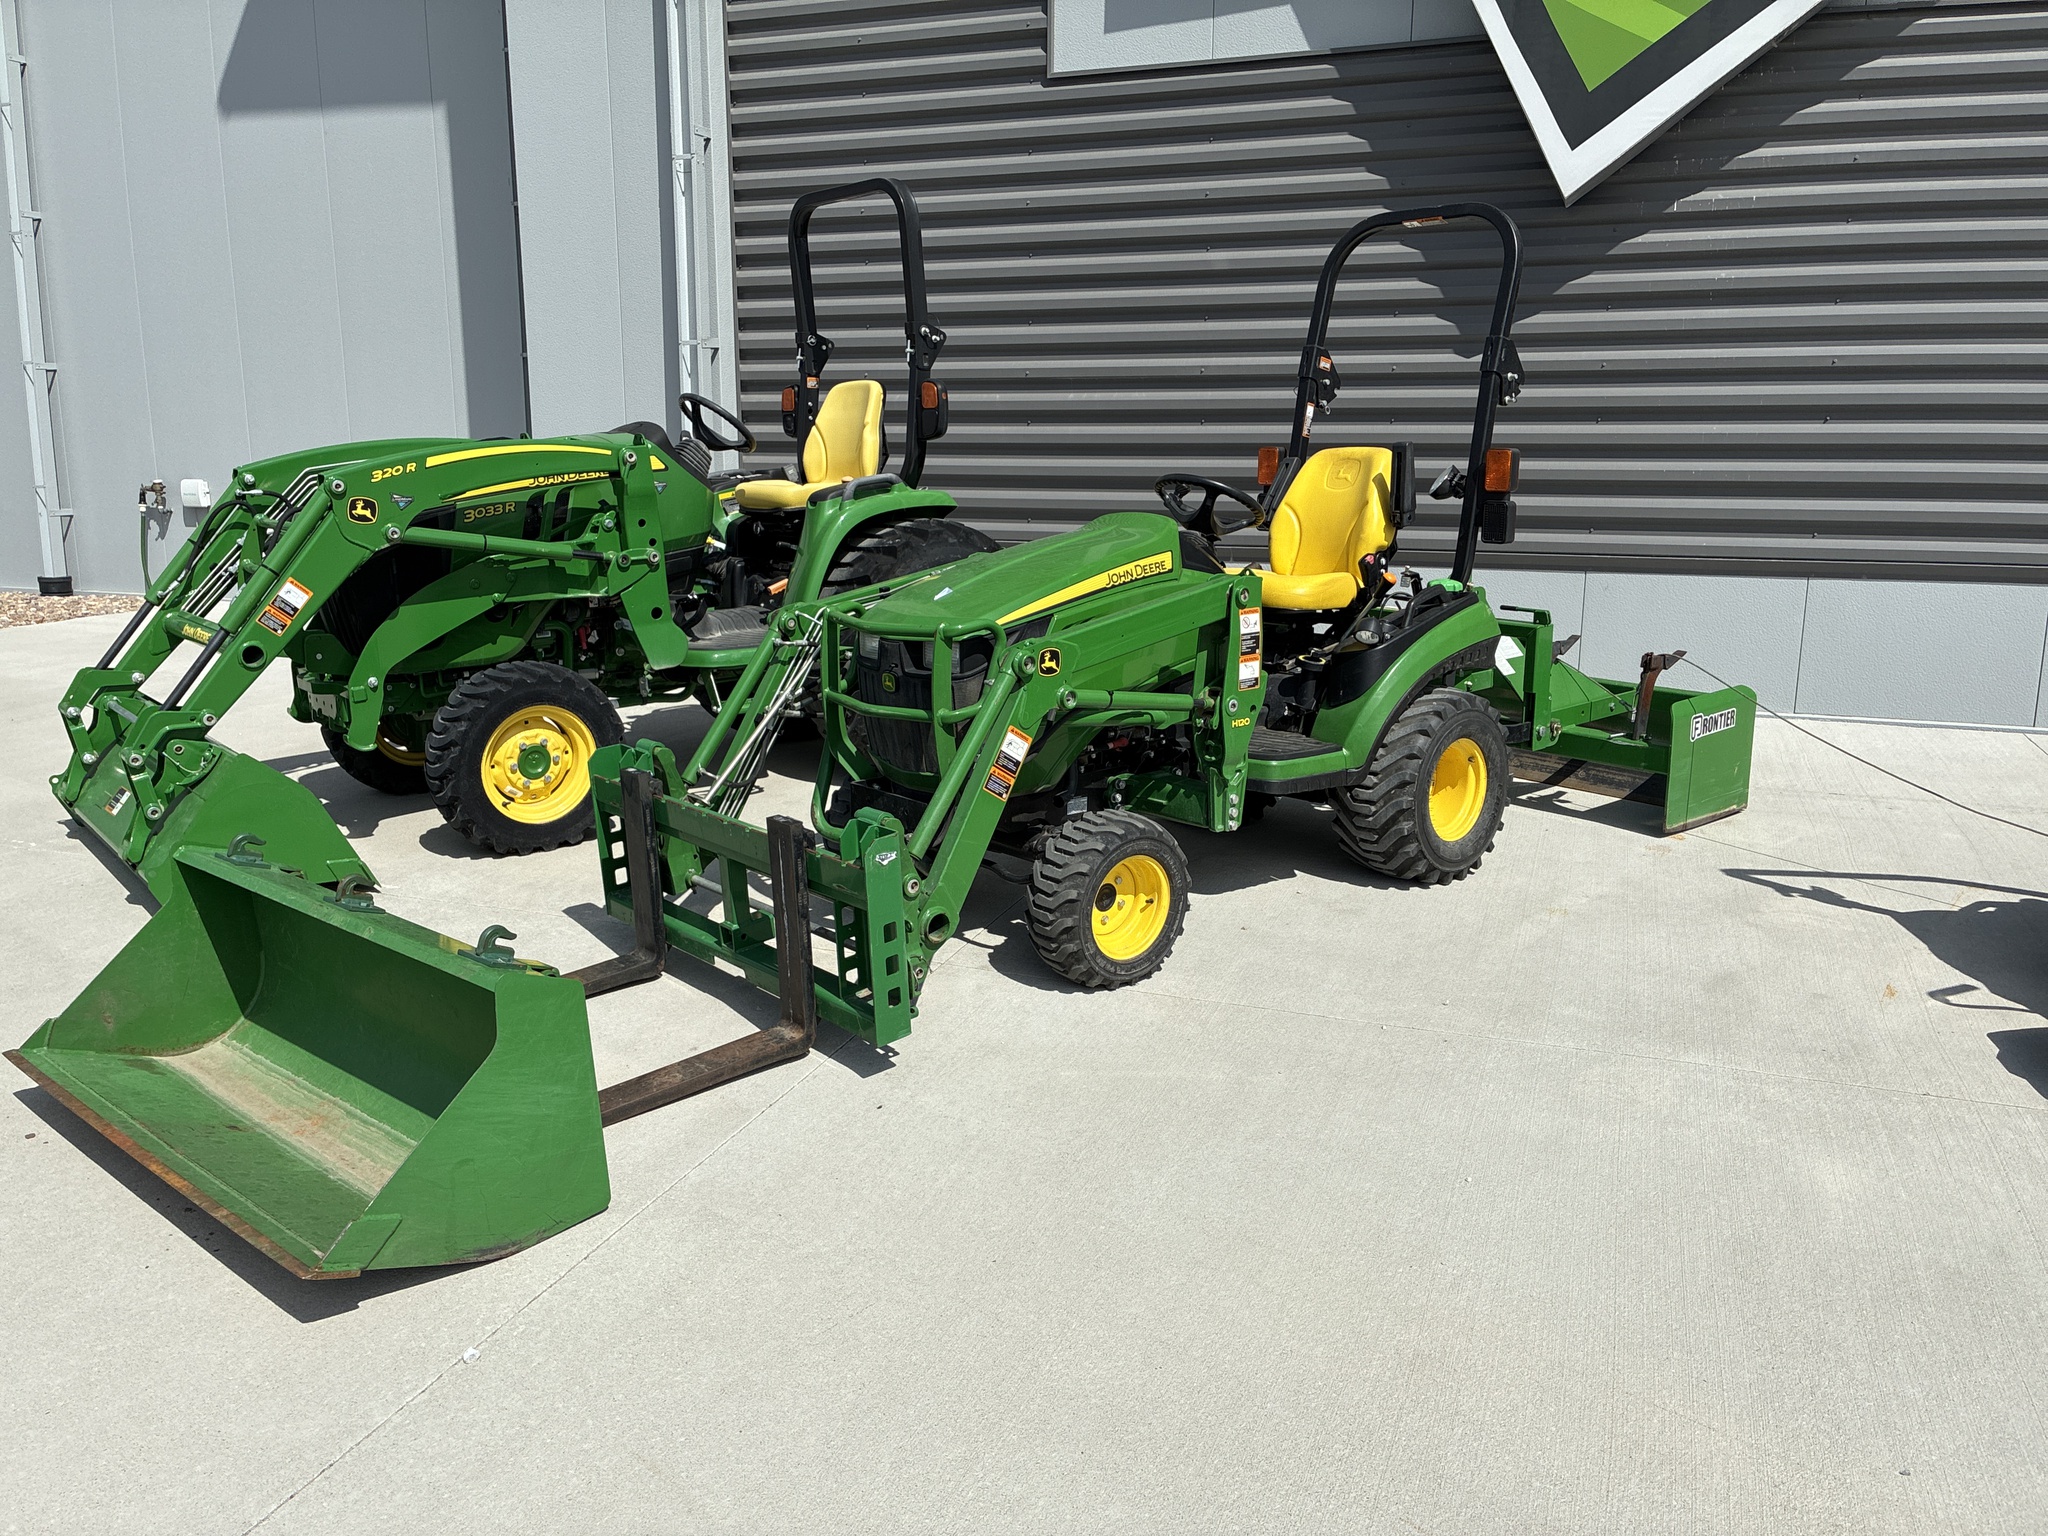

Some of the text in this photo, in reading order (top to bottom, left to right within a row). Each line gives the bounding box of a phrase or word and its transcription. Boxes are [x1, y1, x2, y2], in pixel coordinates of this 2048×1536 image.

[371, 462, 417, 483] 320 R
[464, 502, 515, 522] 3033 R
[1106, 560, 1167, 586] JOHN DEERE
[1691, 709, 1736, 740] FRONTIER
